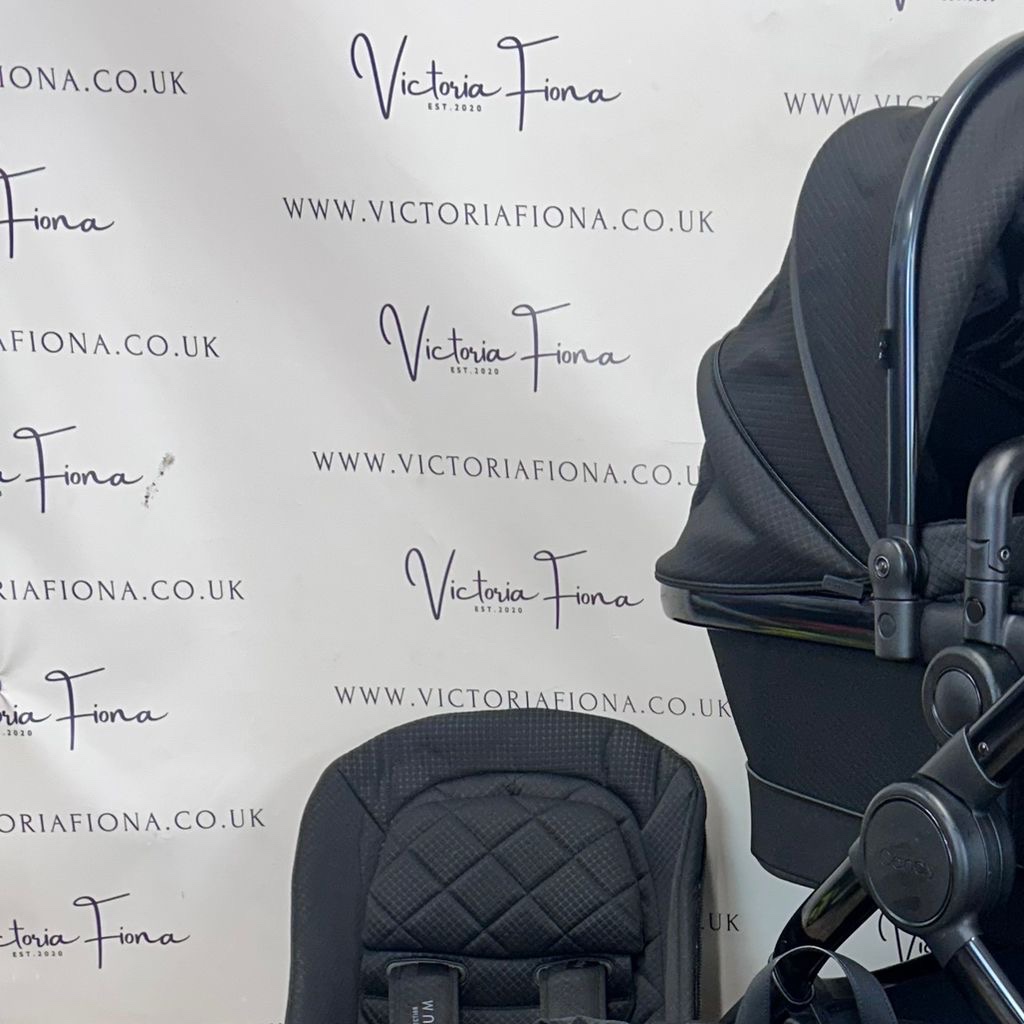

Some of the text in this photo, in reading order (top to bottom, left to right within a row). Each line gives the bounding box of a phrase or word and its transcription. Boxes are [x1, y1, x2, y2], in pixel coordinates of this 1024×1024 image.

[350, 32, 622, 132] Victoria Fiona
[427, 102, 483, 112] EST.2020
[281, 196, 715, 234] WWW.VICTORIAFIONA.CO.UK
[379, 302, 631, 393] Victoria Fiona
[449, 366, 500, 375] EST.2020
[13, 425, 144, 514] Fiona
[404, 548, 645, 630] Victoria Fiona
[44, 667, 169, 751] Fiona
[72, 893, 190, 969] Fiona
